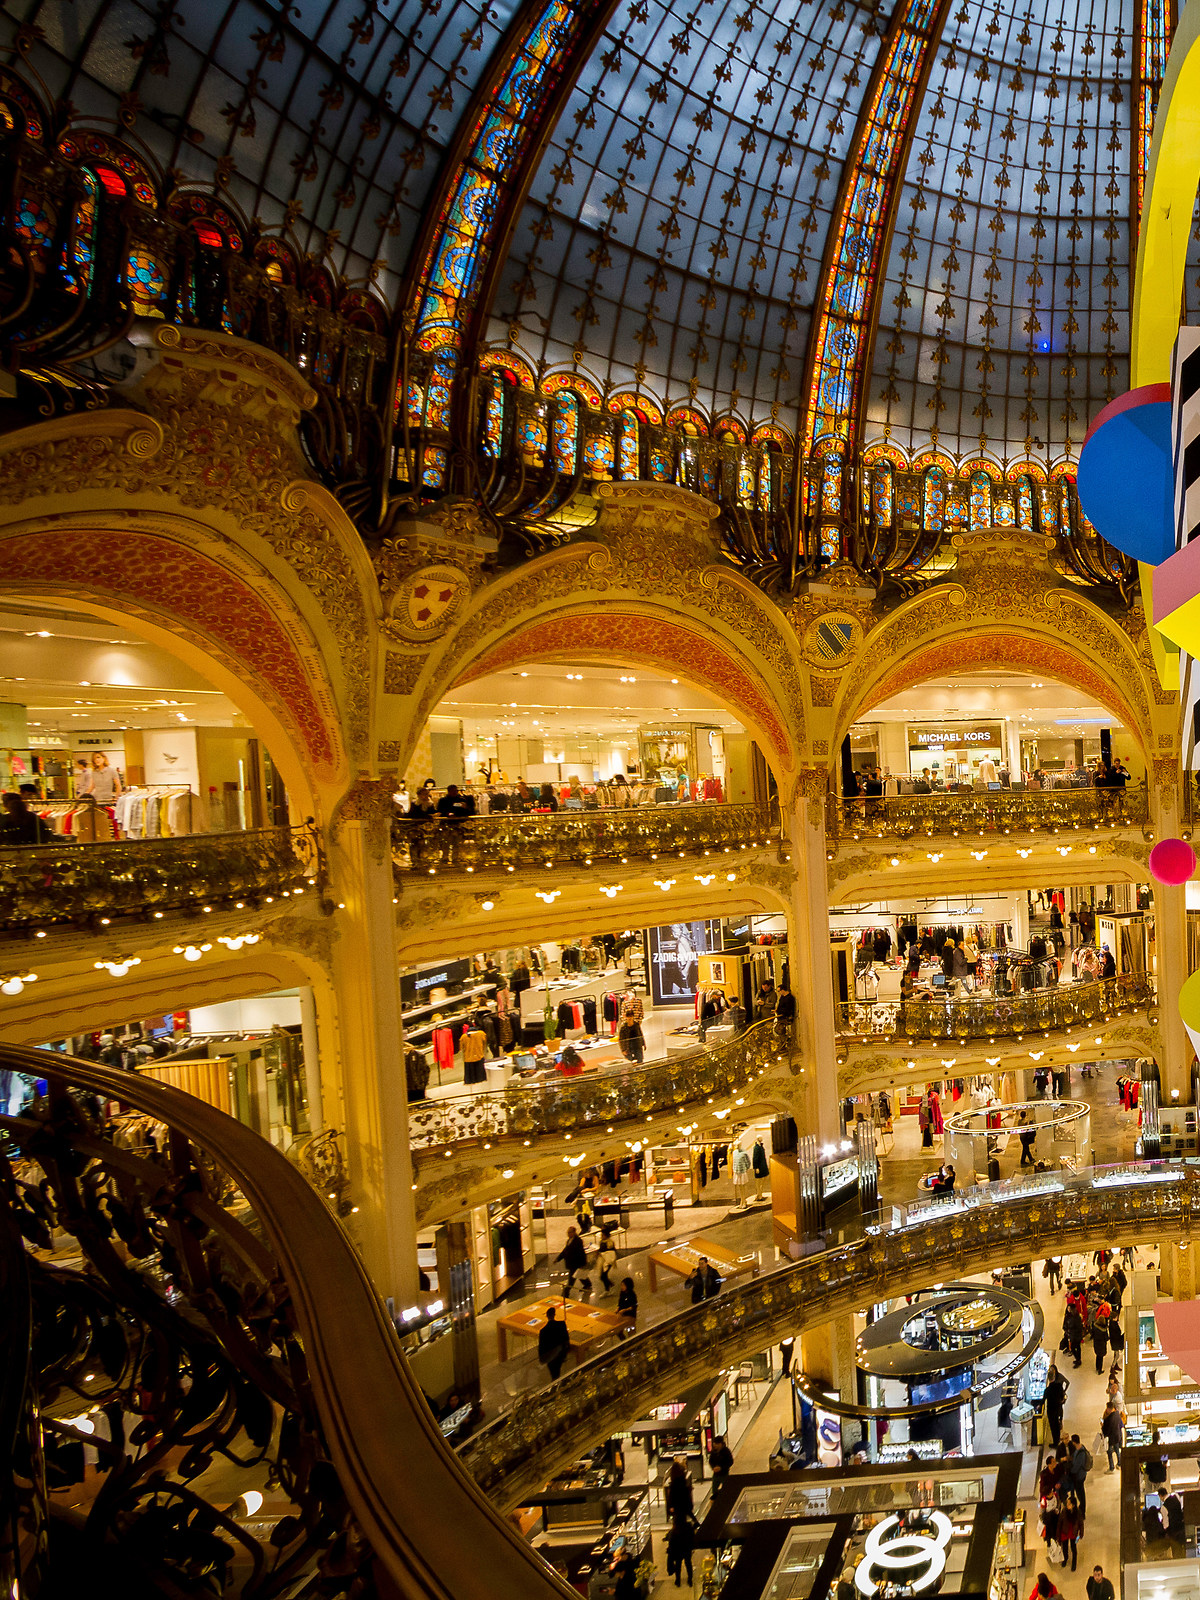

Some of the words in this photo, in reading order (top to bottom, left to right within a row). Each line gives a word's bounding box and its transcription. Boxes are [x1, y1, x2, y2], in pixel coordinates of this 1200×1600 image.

[918, 733, 962, 742] MICHAEL
[963, 732, 991, 741] KORS
[997, 1355, 1026, 1377] LAUDER
